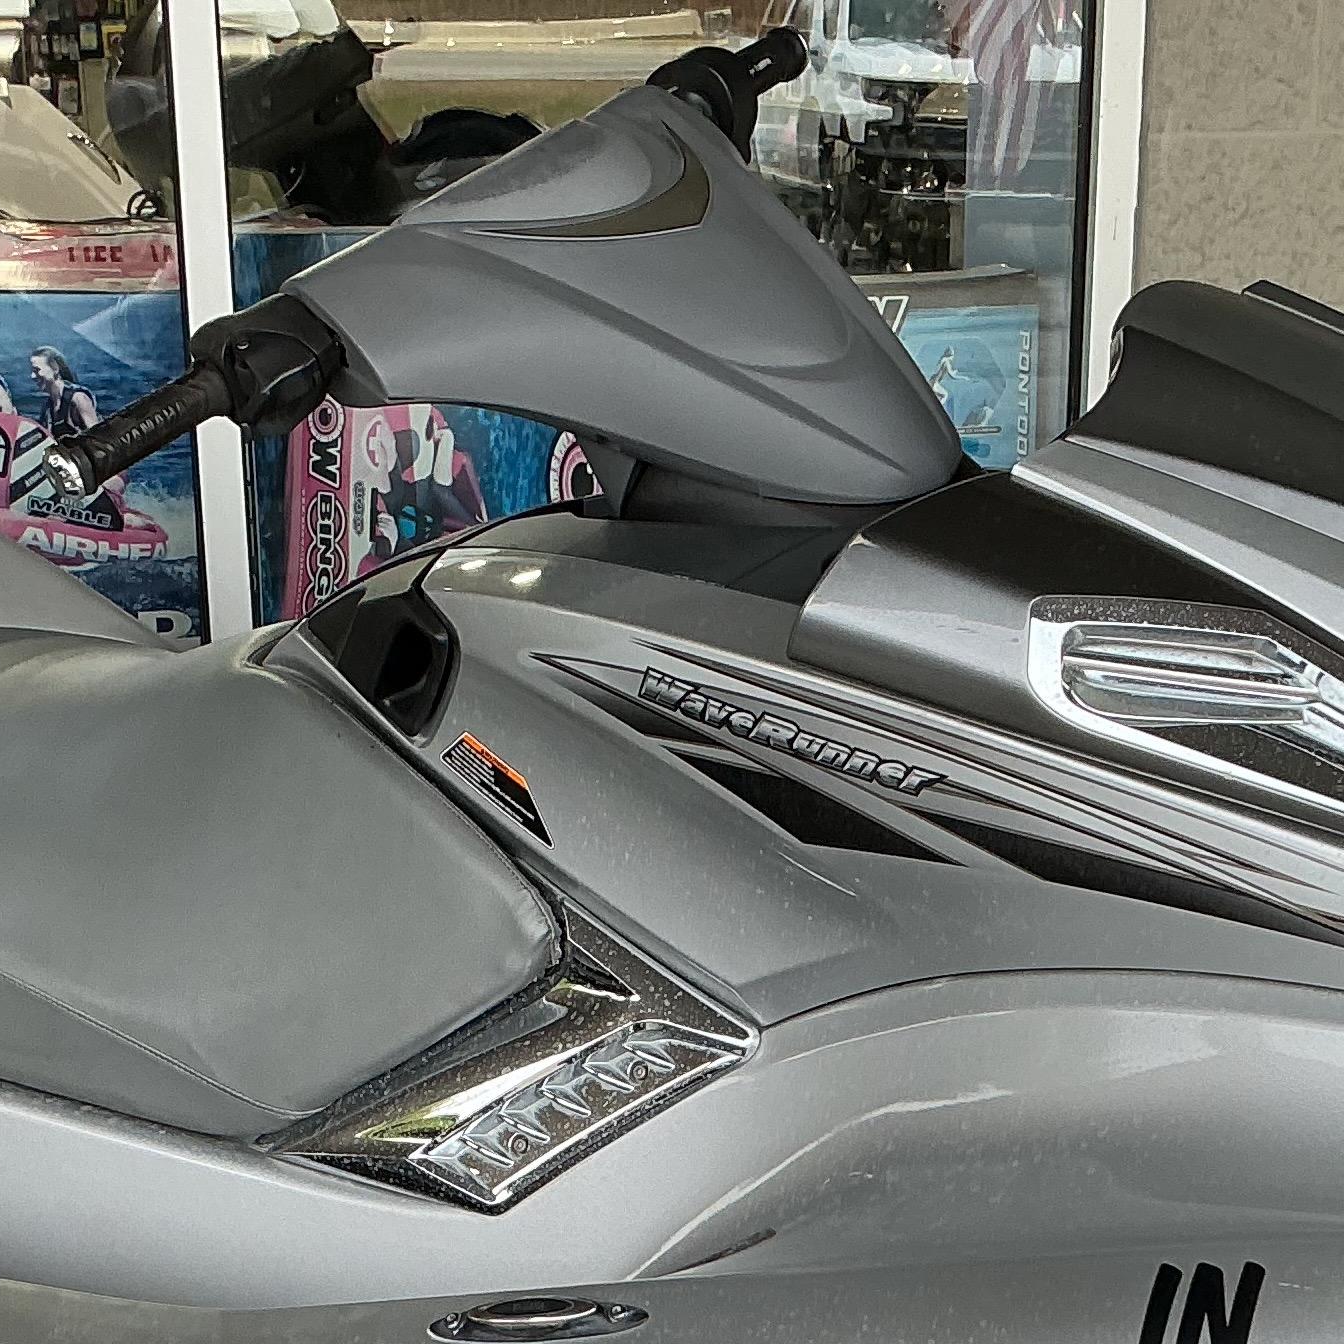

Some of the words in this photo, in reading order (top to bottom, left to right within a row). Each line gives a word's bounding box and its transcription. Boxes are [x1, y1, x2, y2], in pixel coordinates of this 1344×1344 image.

[1017, 329, 1031, 461] PONTOO
[28, 496, 113, 528] MABLE
[314, 490, 336, 604] BING
[637, 666, 949, 797] WaveRunner
